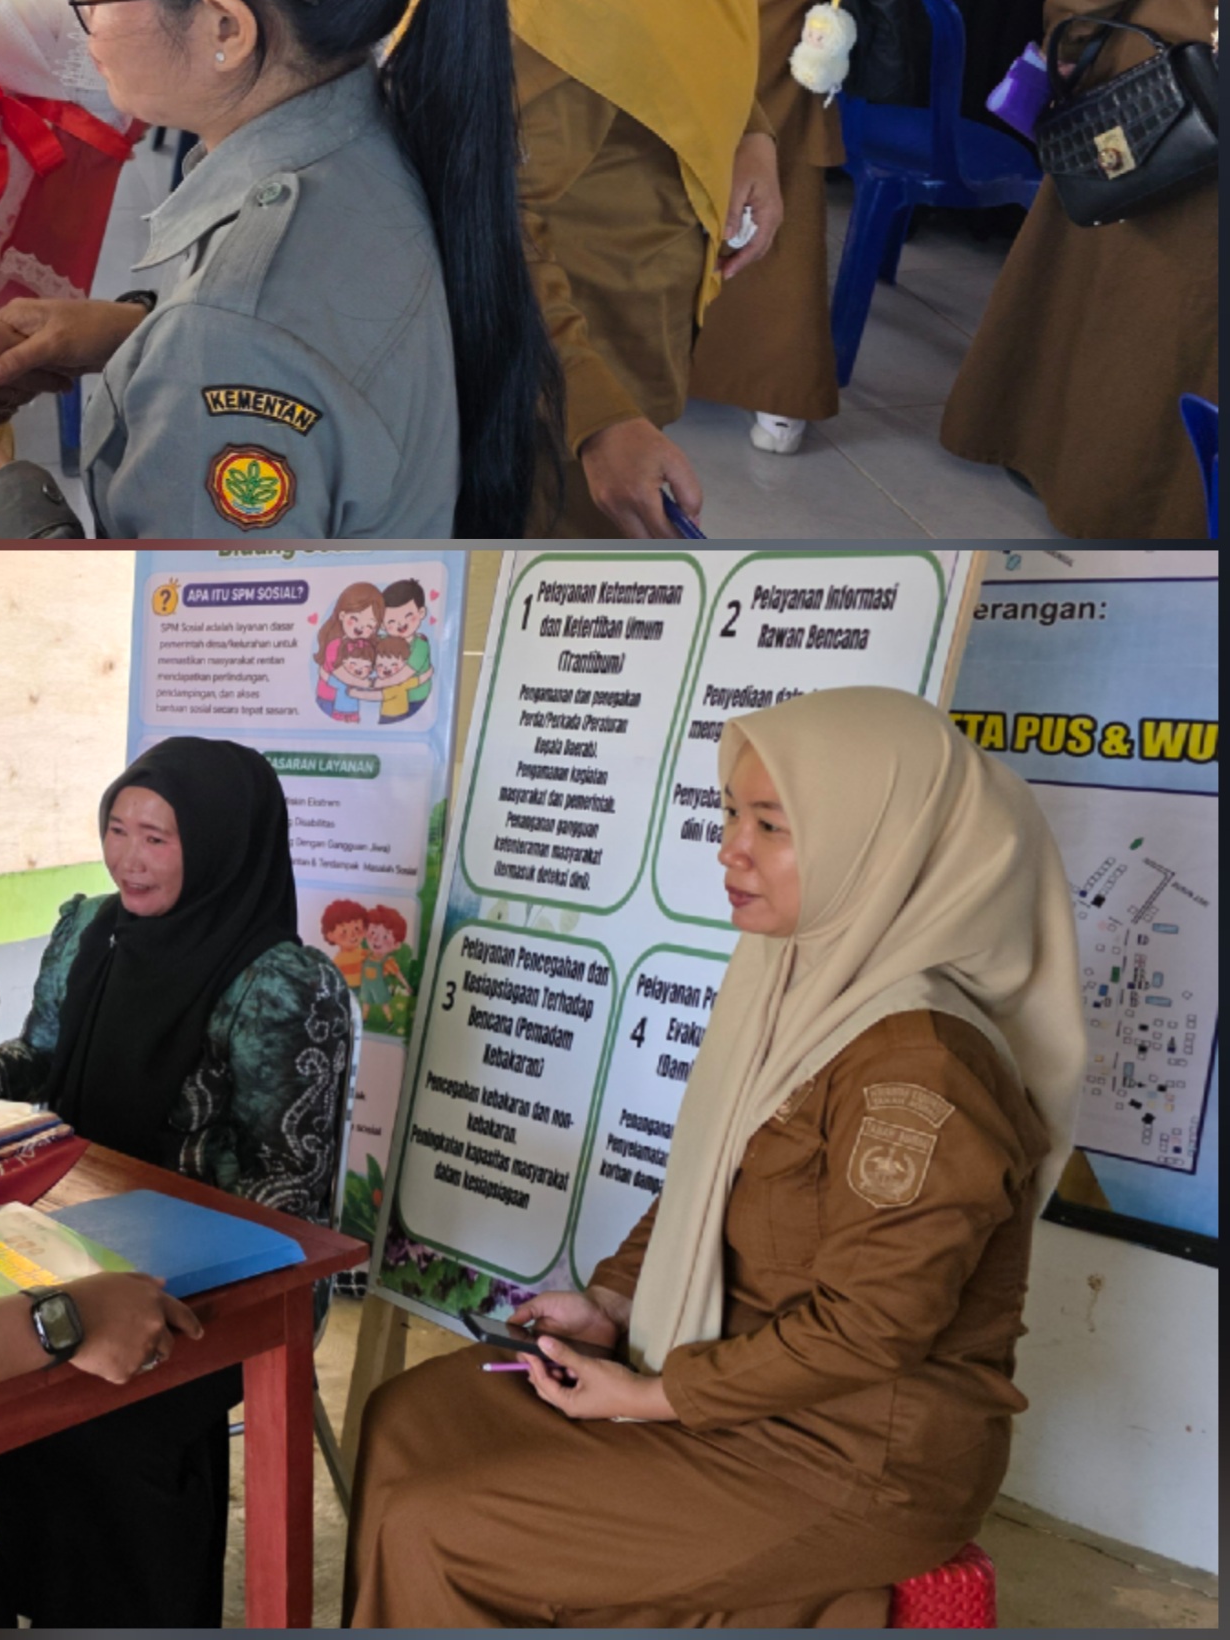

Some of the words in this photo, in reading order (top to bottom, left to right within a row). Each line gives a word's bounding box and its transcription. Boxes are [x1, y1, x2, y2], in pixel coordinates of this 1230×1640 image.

[210, 390, 312, 428] KEMENTAN
[187, 589, 210, 602] APA
[211, 589, 230, 601] ITU
[231, 588, 255, 601] SPM
[256, 586, 304, 600] SOSIAL?
[536, 580, 597, 606] Pelayanan
[751, 585, 824, 613] Pelayanan
[520, 593, 533, 631] 1
[539, 615, 563, 638] dan
[720, 599, 741, 637] 2
[757, 624, 805, 649] Rawan
[805, 625, 871, 650] Bencana
[1011, 712, 1097, 757] PUS
[1099, 720, 1135, 759] &
[461, 935, 516, 968] Pelayanan
[587, 960, 610, 987] dan
[442, 980, 457, 1011] 3
[636, 973, 701, 1006] Pelayanan
[468, 1005, 514, 1036] Bencana
[630, 1016, 648, 1049] 4
